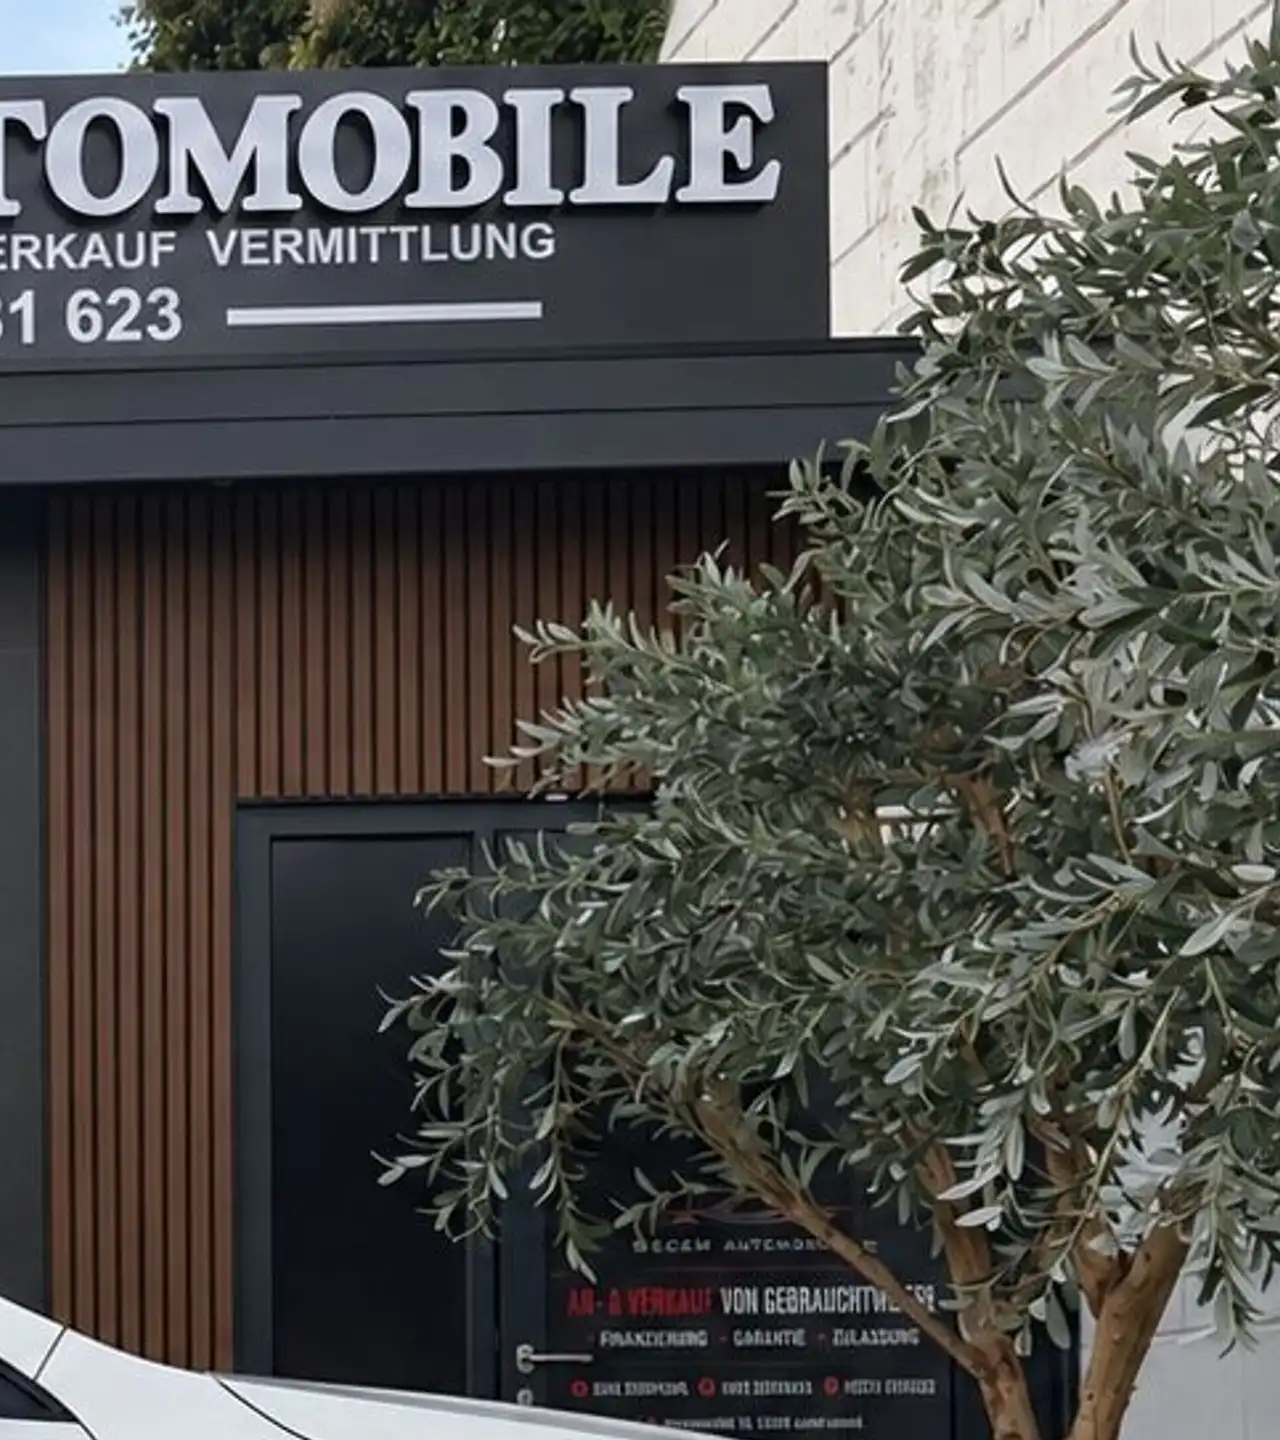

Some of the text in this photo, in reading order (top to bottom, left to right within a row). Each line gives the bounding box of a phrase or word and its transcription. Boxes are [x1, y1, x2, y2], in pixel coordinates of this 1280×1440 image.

[205, 221, 556, 267] VERMITTLUNG
[65, 286, 182, 343] 623
[720, 1285, 760, 1315] VON
